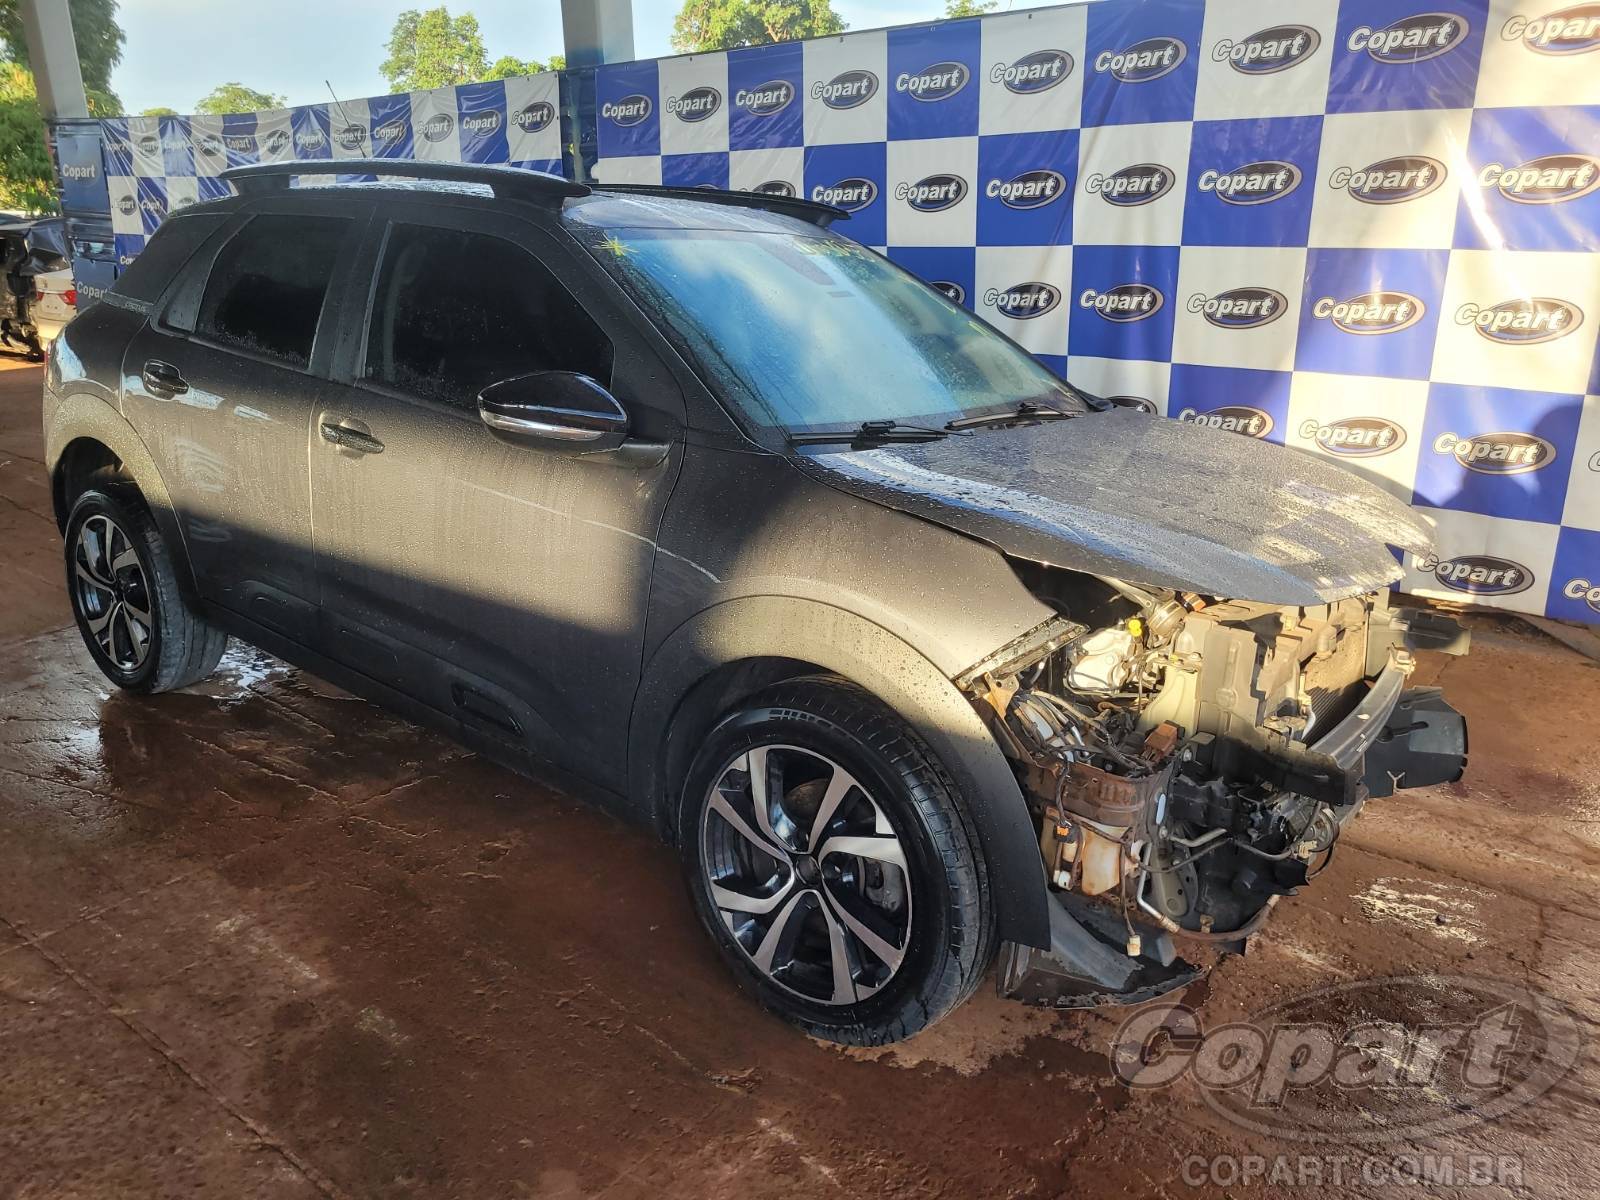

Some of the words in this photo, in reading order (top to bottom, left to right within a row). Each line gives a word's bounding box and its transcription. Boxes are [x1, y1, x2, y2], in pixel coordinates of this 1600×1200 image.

[1211, 34, 1306, 69] Copart
[1347, 18, 1455, 60] Copart
[990, 57, 1064, 91] Copart
[1094, 47, 1176, 80] Copart
[735, 84, 787, 109] Copart
[811, 76, 871, 105] Copart
[896, 67, 963, 98] Copart
[511, 106, 549, 127] Copart
[601, 101, 646, 121] Copart
[666, 91, 713, 114] Copart
[417, 117, 448, 137] Copart
[463, 113, 498, 130] Copart
[62, 164, 96, 179] Copart
[1198, 167, 1289, 201] Copart
[1329, 164, 1436, 200] Copart
[1479, 161, 1594, 194] Copart
[812, 184, 871, 206] Copart
[894, 180, 961, 207] Copart
[986, 172, 1064, 203] Copart
[1085, 172, 1163, 202] Copart
[984, 287, 1050, 310] Copart
[1079, 289, 1156, 312] Copart
[1187, 293, 1276, 320] Copart
[1313, 297, 1415, 328] Copart
[1454, 302, 1567, 334] Copart
[1299, 418, 1396, 448] Copart
[1433, 432, 1542, 465] Copart
[1417, 554, 1519, 587] Copart
